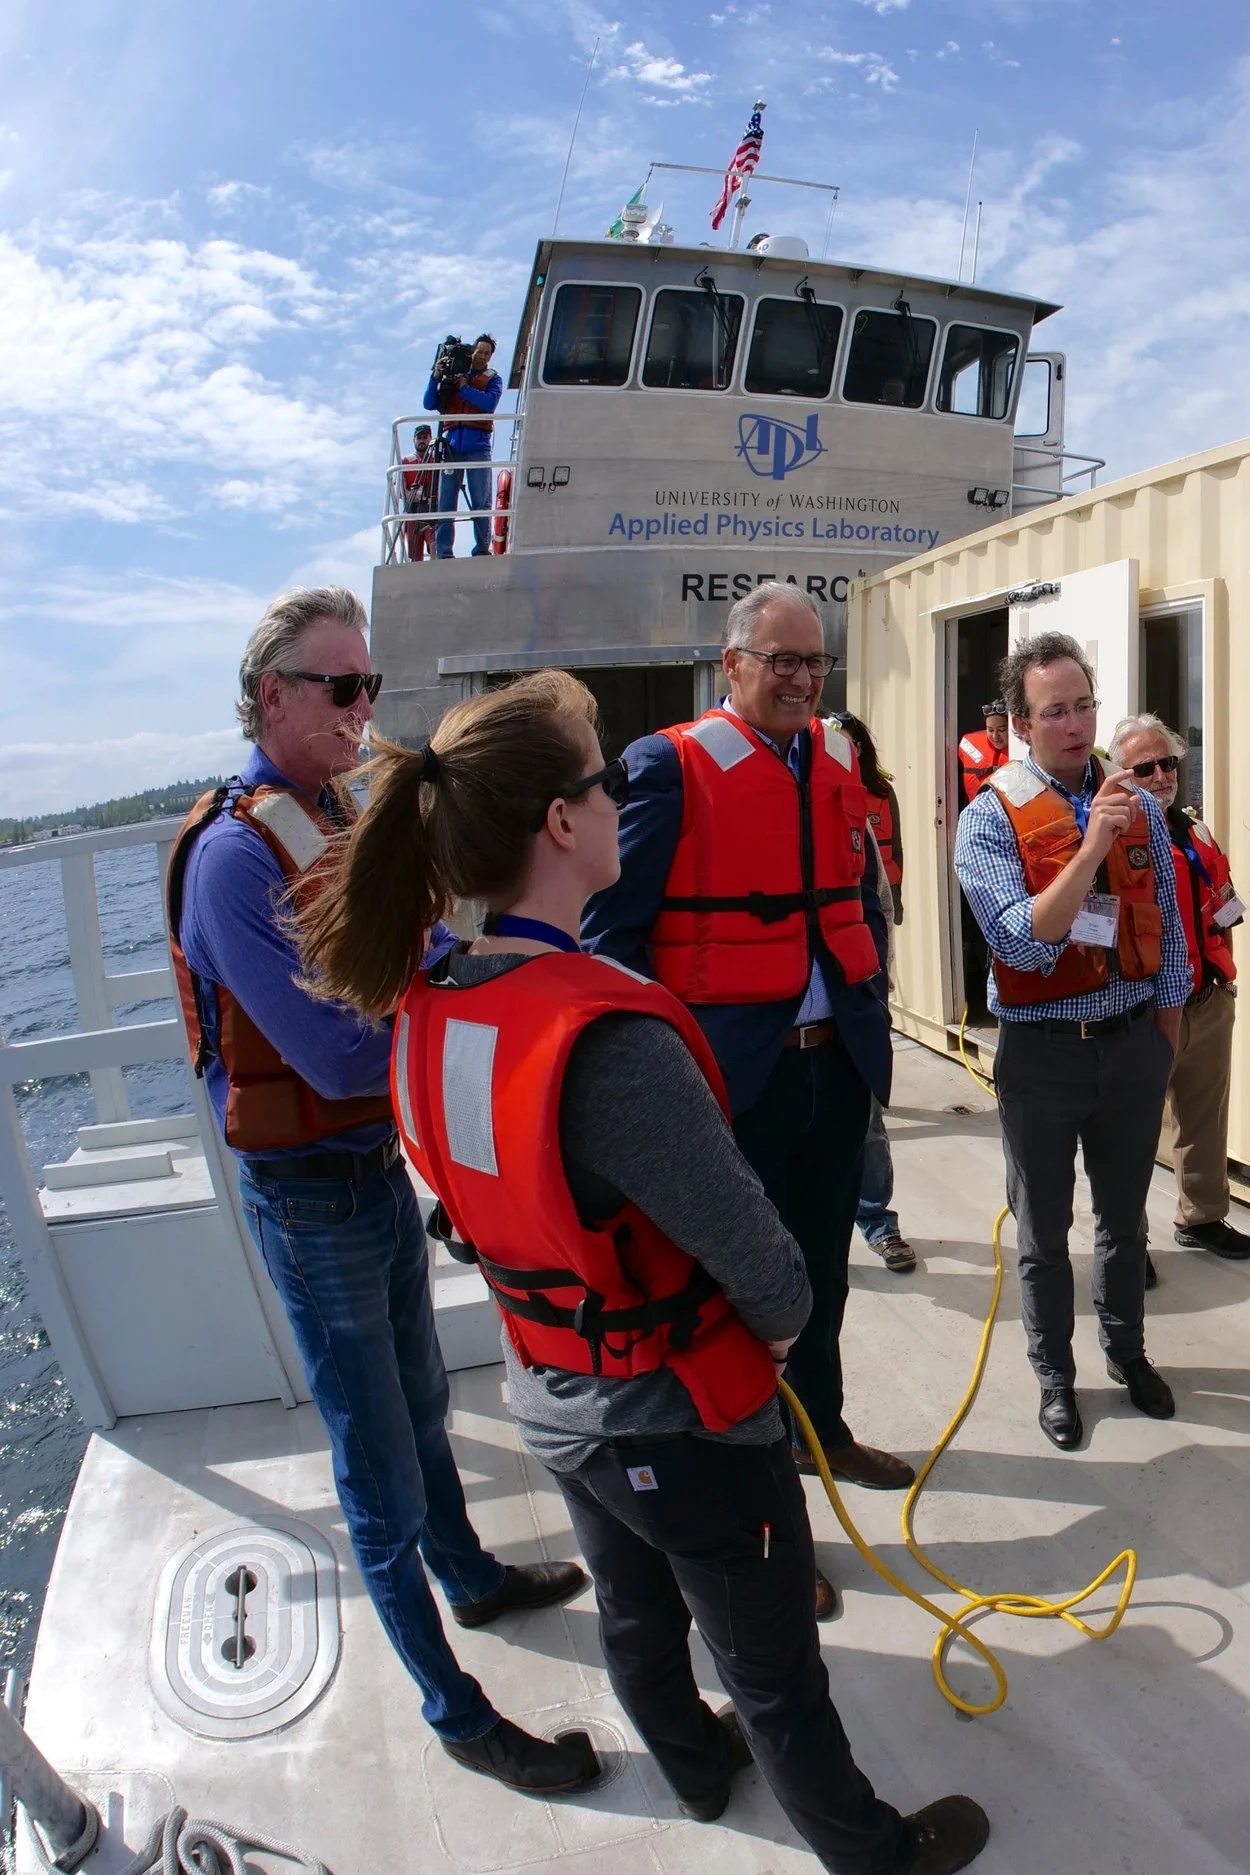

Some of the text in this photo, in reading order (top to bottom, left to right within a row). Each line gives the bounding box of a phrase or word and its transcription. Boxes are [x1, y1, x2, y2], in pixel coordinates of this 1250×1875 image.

[655, 491, 901, 513] UNIVERSITY of WASHINGTON
[608, 512, 940, 550] Applied Physics Laboratory
[180, 1596, 193, 1645] FREEMAN
